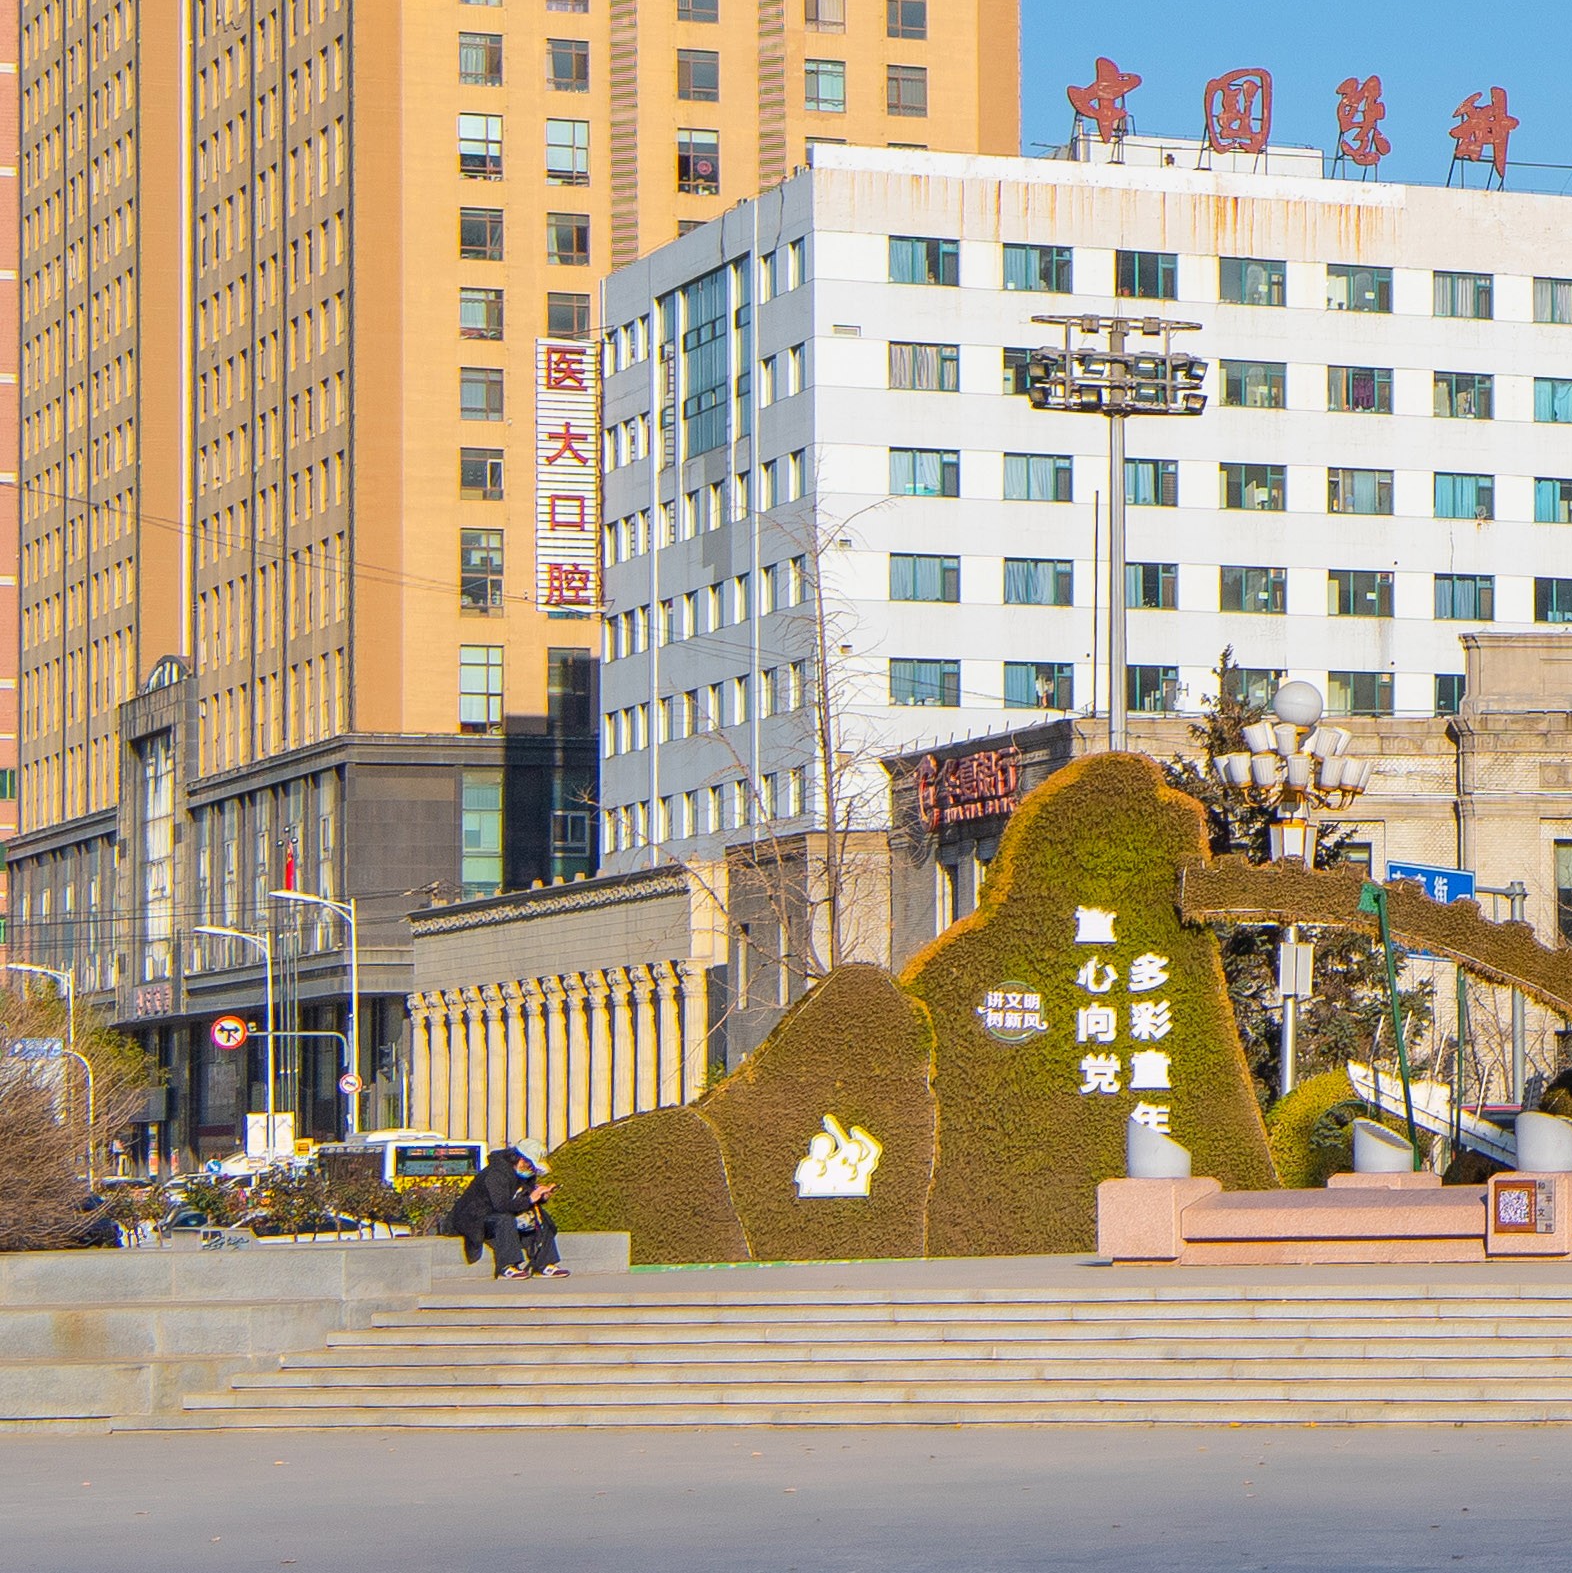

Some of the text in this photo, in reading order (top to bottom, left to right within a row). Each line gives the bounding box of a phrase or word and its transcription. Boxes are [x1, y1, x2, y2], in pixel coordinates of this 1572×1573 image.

[544, 345, 592, 606] 医大口腔
[986, 990, 1042, 1010] 讲文明
[980, 1008, 1049, 1032] 树新风
